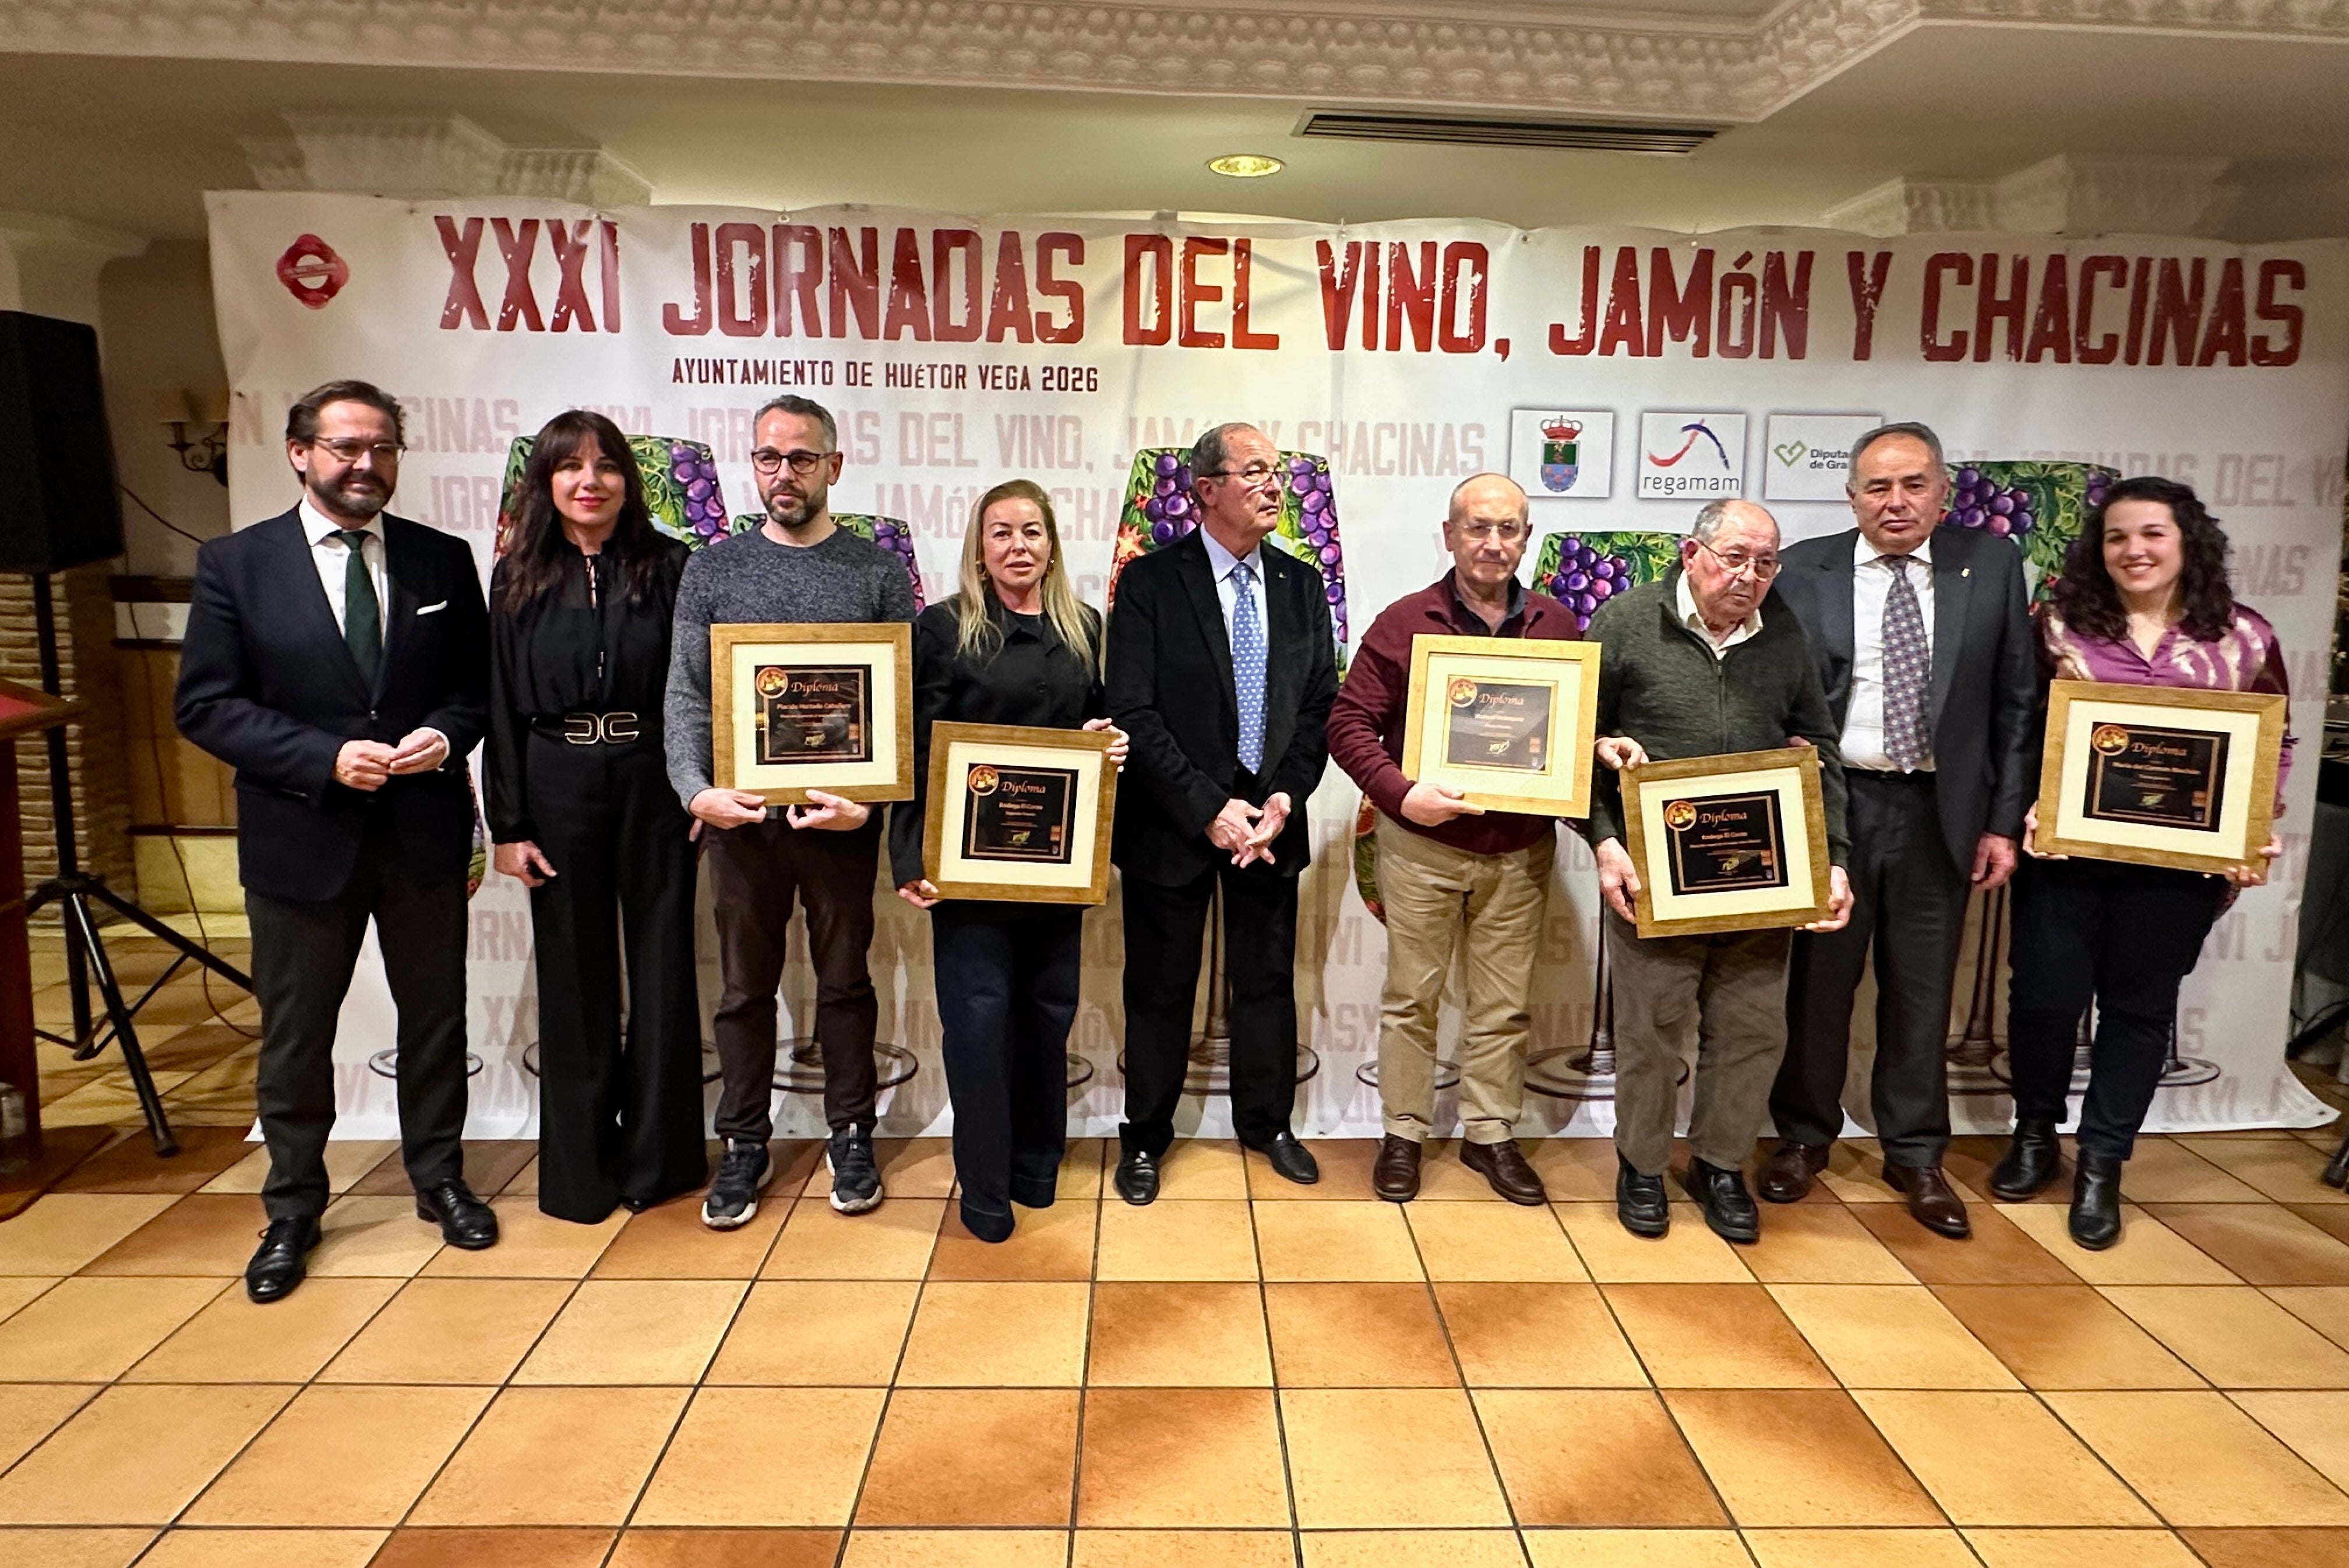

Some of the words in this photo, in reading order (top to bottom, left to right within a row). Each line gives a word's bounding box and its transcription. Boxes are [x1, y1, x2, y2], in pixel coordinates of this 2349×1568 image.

[434, 216, 620, 333] XXXI
[662, 222, 1085, 344] JORNADAS
[1123, 234, 1279, 349] DEL
[1316, 239, 1510, 362] VINO,
[1549, 246, 1815, 359] JAMÓN
[1847, 251, 1893, 361] Y
[1921, 252, 2306, 367] CHACINAS
[672, 358, 834, 386] AYUNTAMIENTO
[846, 361, 873, 387] DE
[978, 365, 1032, 391] VEGA
[1042, 366, 1098, 392] 2026
[899, 412, 978, 466] DEL
[994, 414, 1094, 473] VINO,
[1810, 448, 1849, 460] Diputa
[1810, 460, 1824, 469] de
[1643, 475, 1740, 495] regamam
[791, 679, 838, 697] Diploma
[1480, 693, 1524, 708] Diploma
[2131, 741, 2187, 758] Diploma
[1000, 780, 1046, 796] Diploma
[1699, 808, 1748, 827] Diploma
